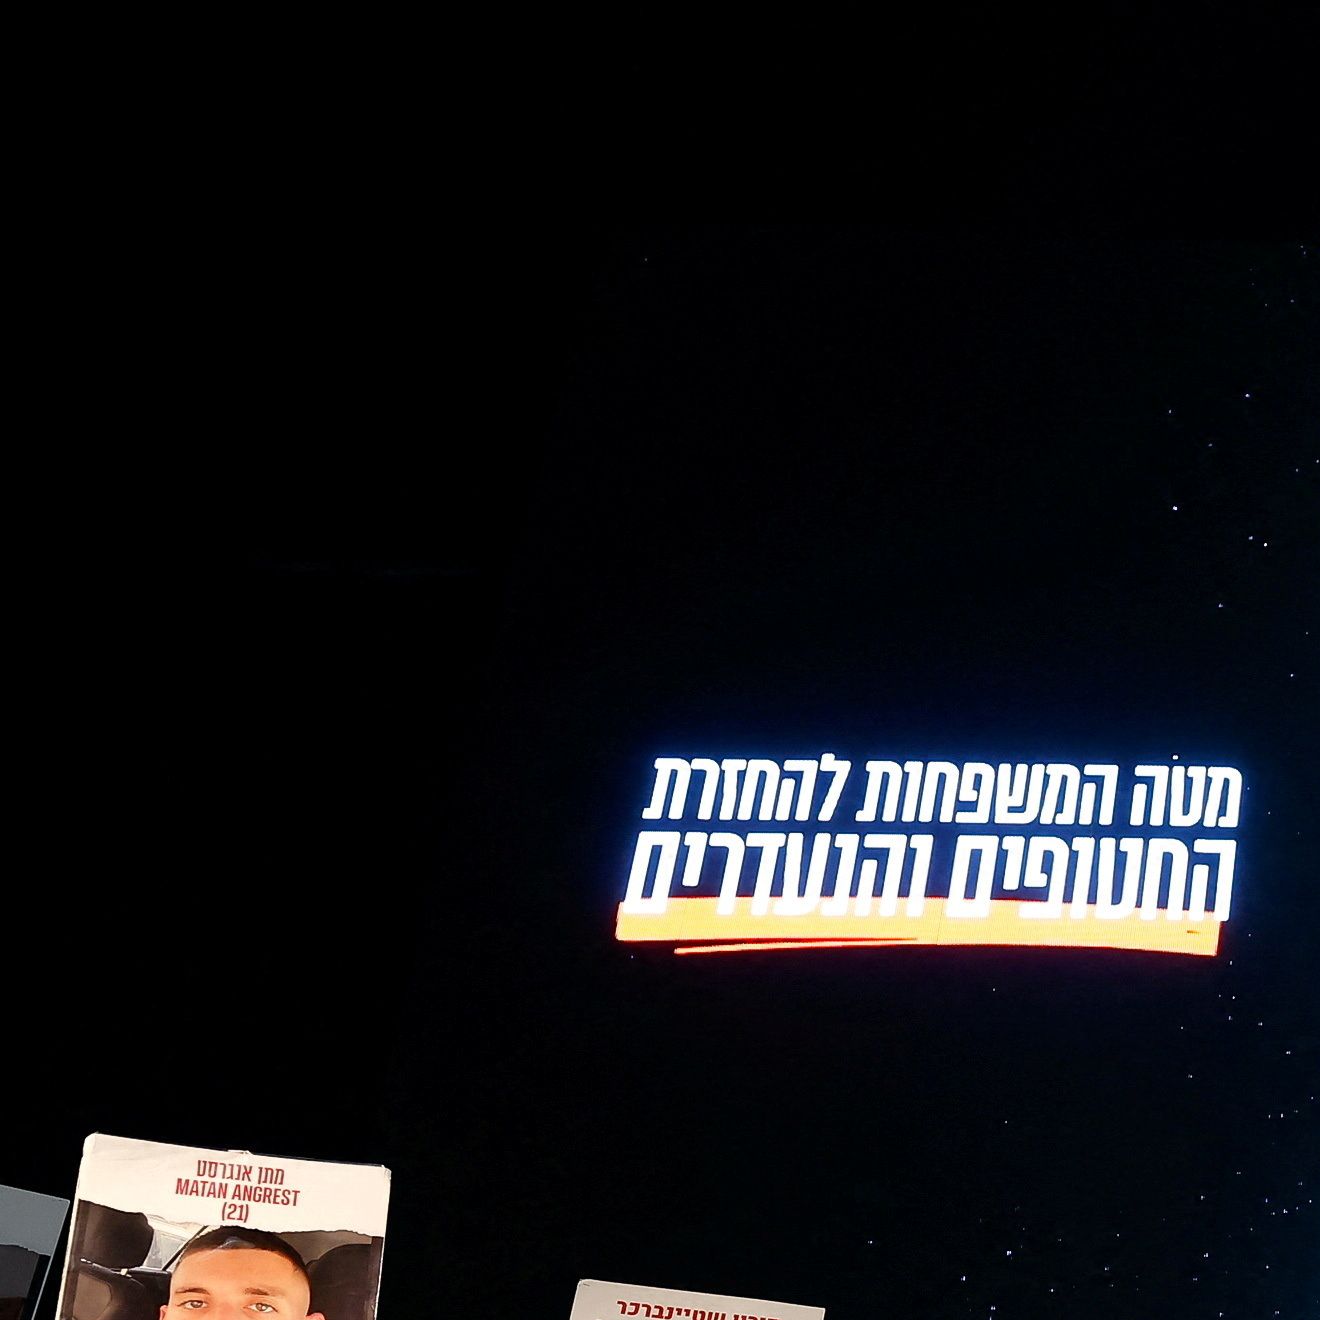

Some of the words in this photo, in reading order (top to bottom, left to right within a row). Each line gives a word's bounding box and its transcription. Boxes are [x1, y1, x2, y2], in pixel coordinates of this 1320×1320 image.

[641, 753, 851, 822] להחזרת
[863, 758, 1119, 826] המשפחות
[1131, 764, 1243, 828] מטה
[623, 831, 934, 917] והנעדרים
[946, 835, 1237, 921] החטופים
[175, 1178, 230, 1203] MATAN
[232, 1185, 300, 1208] ANGREST
[197, 1160, 251, 1183] אנגרסט
[252, 1165, 286, 1186] מתן
[221, 1203, 250, 1224] (21)
